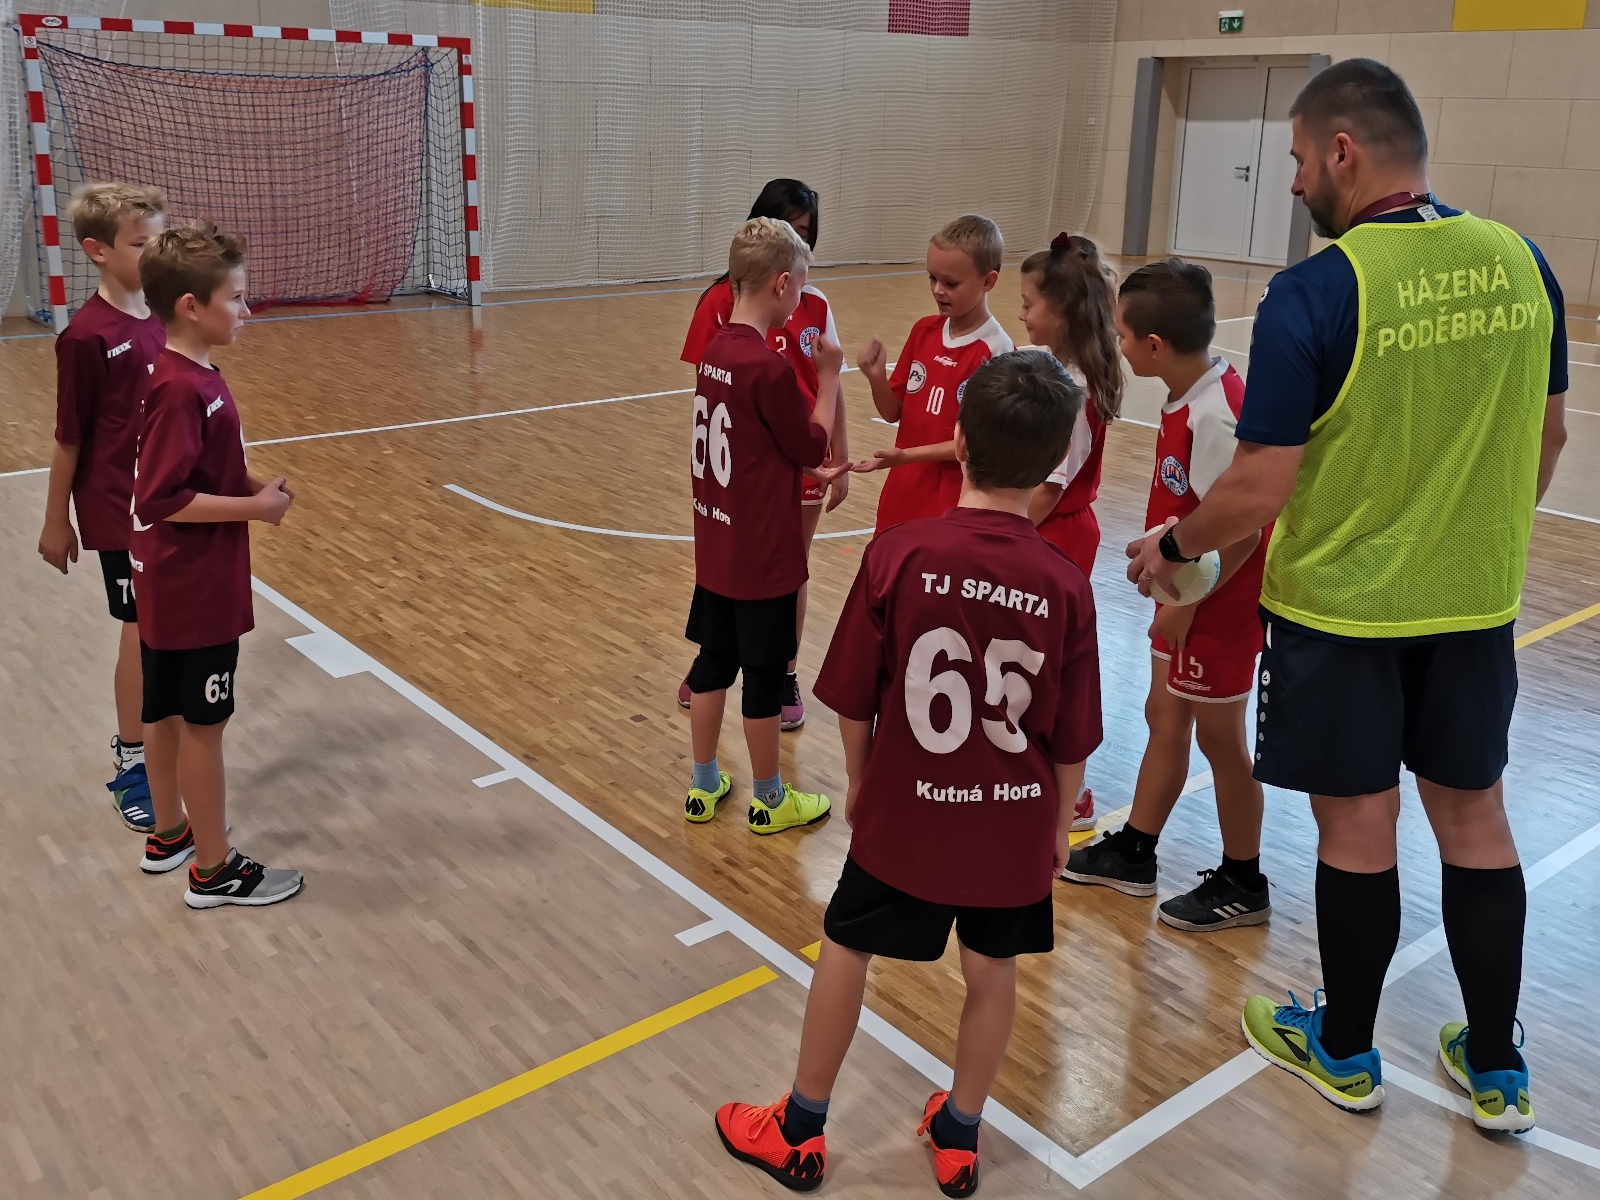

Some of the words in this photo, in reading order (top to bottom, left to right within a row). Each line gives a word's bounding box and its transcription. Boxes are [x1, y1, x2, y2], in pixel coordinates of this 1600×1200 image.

[1397, 255, 1510, 309] HÁZENÁ
[1377, 301, 1540, 358] PODĚBRADY
[703, 363, 732, 386] SPARTA
[926, 385, 945, 416] 10
[691, 394, 733, 489] 66
[921, 572, 951, 595] TJ
[960, 578, 1050, 619] SPARTA
[204, 670, 230, 704] 63
[904, 626, 1045, 754] 65
[916, 779, 983, 803] Kutná
[993, 782, 1042, 801] Hora
